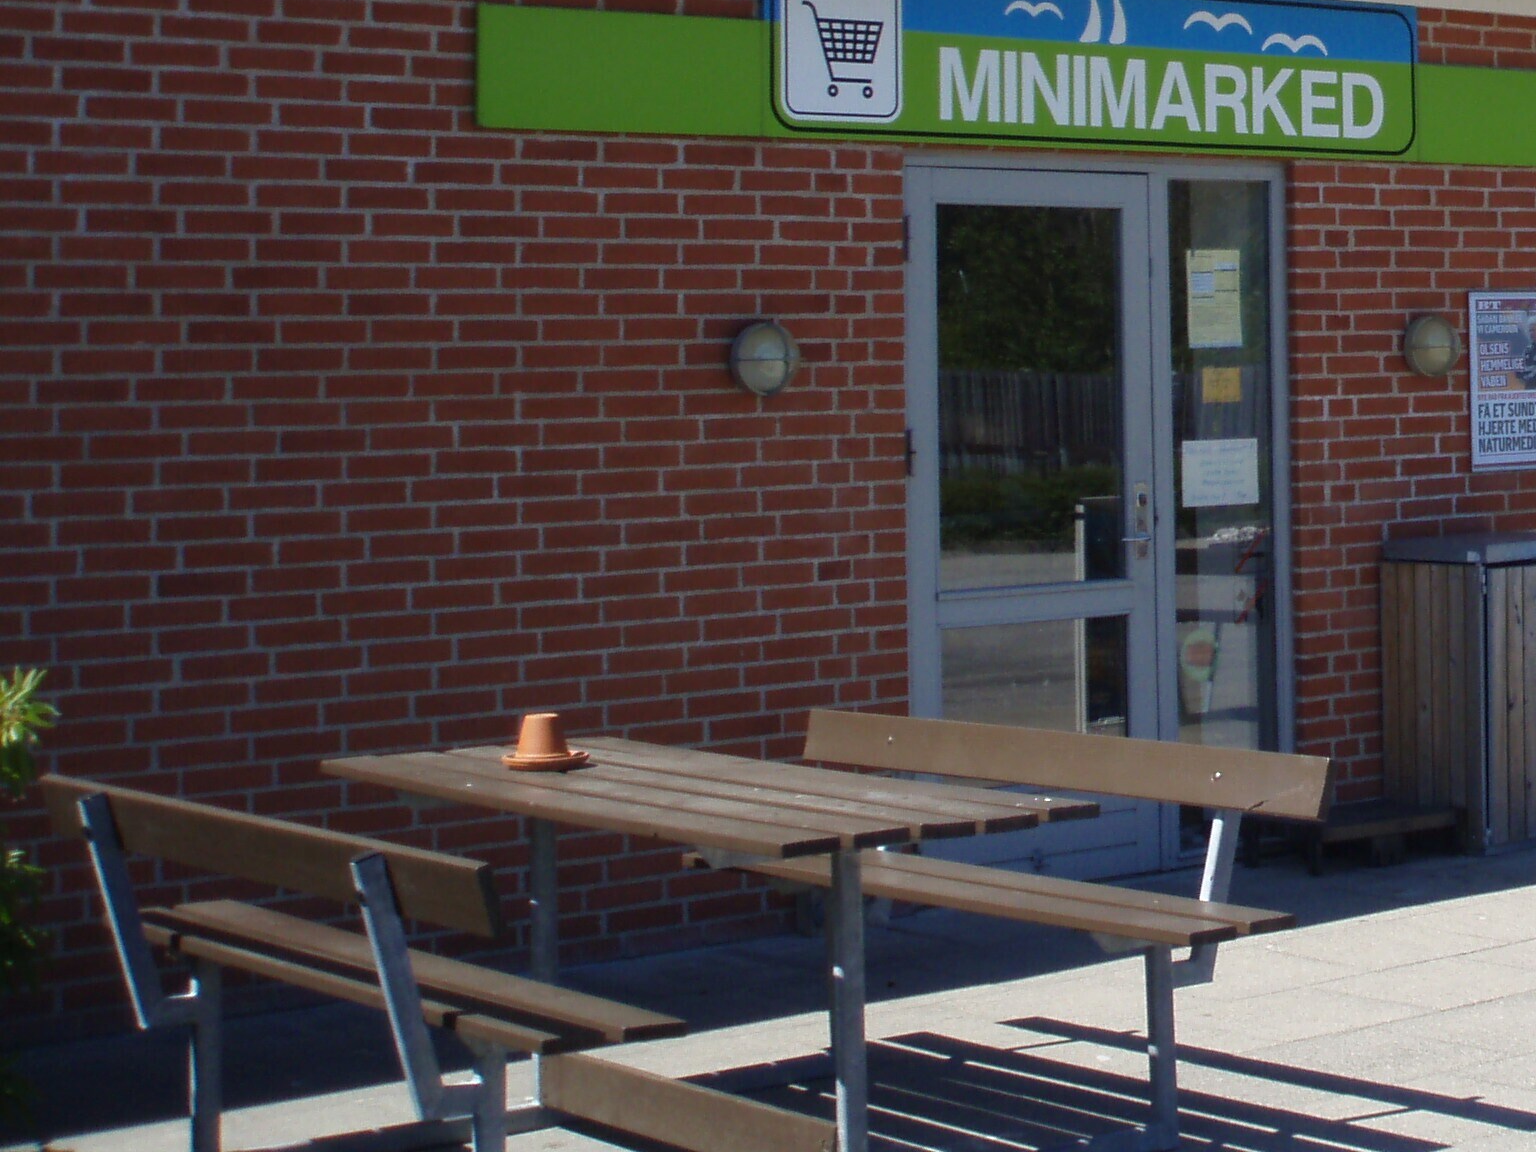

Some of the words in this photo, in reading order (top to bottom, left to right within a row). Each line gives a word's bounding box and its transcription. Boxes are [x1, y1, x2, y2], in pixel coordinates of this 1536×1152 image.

[938, 46, 1384, 140] MINIMARKED
[1493, 403, 1506, 418] ET
[1478, 420, 1516, 436] HJERTE
